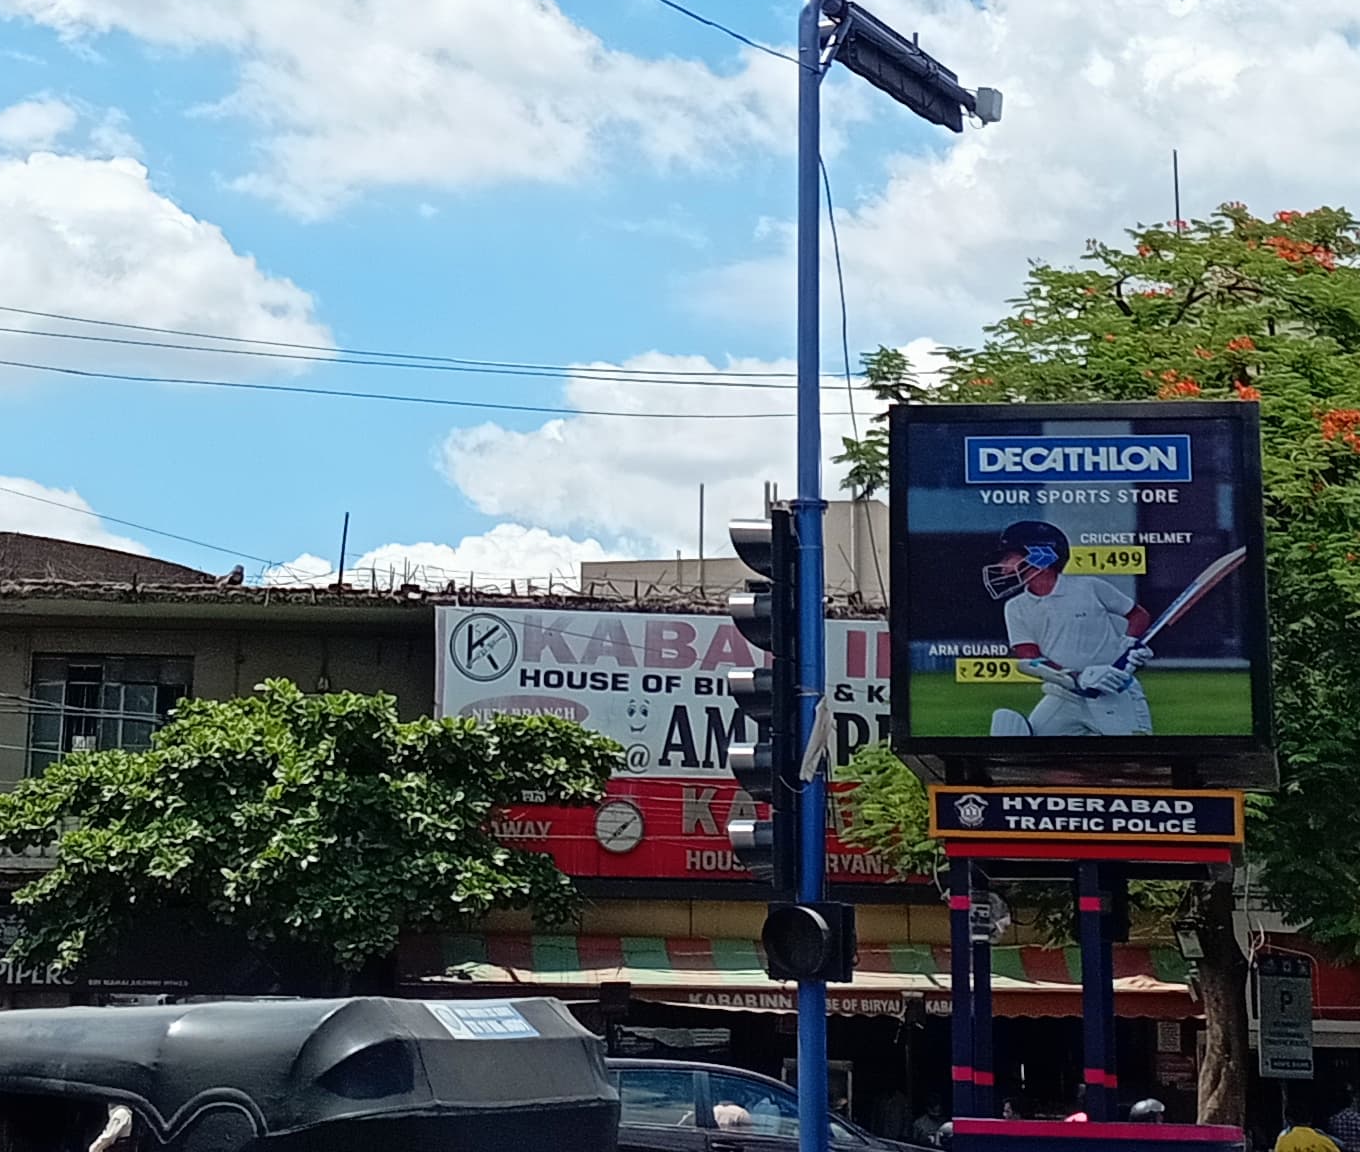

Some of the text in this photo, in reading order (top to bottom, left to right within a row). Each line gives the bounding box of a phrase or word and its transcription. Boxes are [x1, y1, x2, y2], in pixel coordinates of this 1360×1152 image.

[979, 447, 1178, 473] DECATHLON
[980, 489, 1179, 505] YOUR SPORTS STORE
[1080, 533, 1192, 544] CRICKET HELMET
[1088, 552, 1143, 570] 1,499
[522, 614, 773, 671] KABA
[929, 645, 1008, 656] ARM GUARD
[973, 662, 1011, 678] 299
[520, 669, 630, 692] HOUSE
[642, 675, 683, 694] OF
[834, 684, 856, 703] &
[626, 743, 651, 774] @
[1002, 796, 1194, 814] HYDERABAD
[1005, 815, 1105, 832] TRAFFIC
